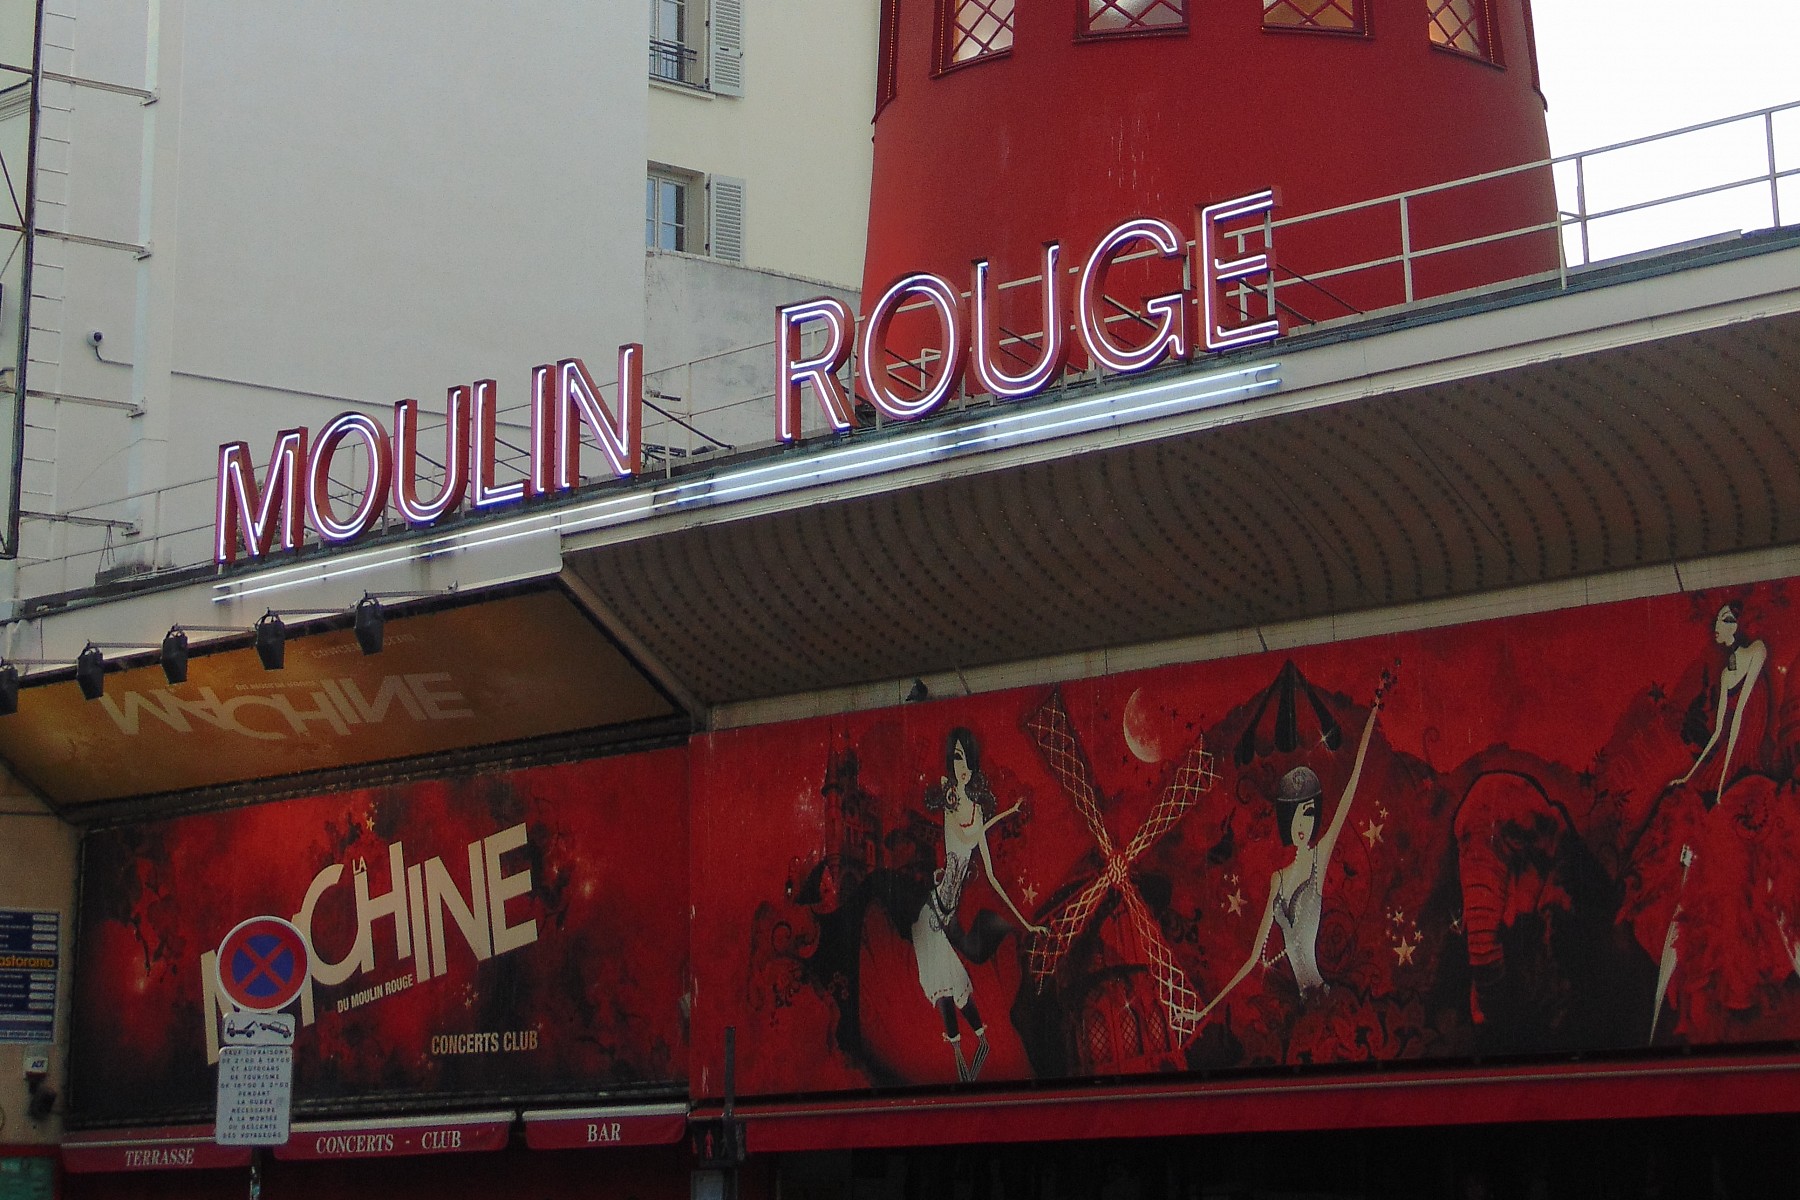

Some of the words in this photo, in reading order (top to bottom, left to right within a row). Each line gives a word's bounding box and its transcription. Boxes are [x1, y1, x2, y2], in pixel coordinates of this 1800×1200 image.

[215, 343, 642, 561] MOULIN
[776, 188, 1281, 438] ROUGE
[352, 856, 367, 874] LA
[337, 998, 351, 1014] DU
[351, 984, 384, 1008] MOULIN
[385, 973, 414, 998] ROUGE
[431, 1032, 499, 1055] CONCERTS
[503, 1030, 538, 1052] CLUB
[315, 1134, 394, 1154] CONCERTS
[421, 1130, 461, 1149] CLUB
[587, 1122, 622, 1142] BAR
[125, 1147, 195, 1167] TERRASSE
